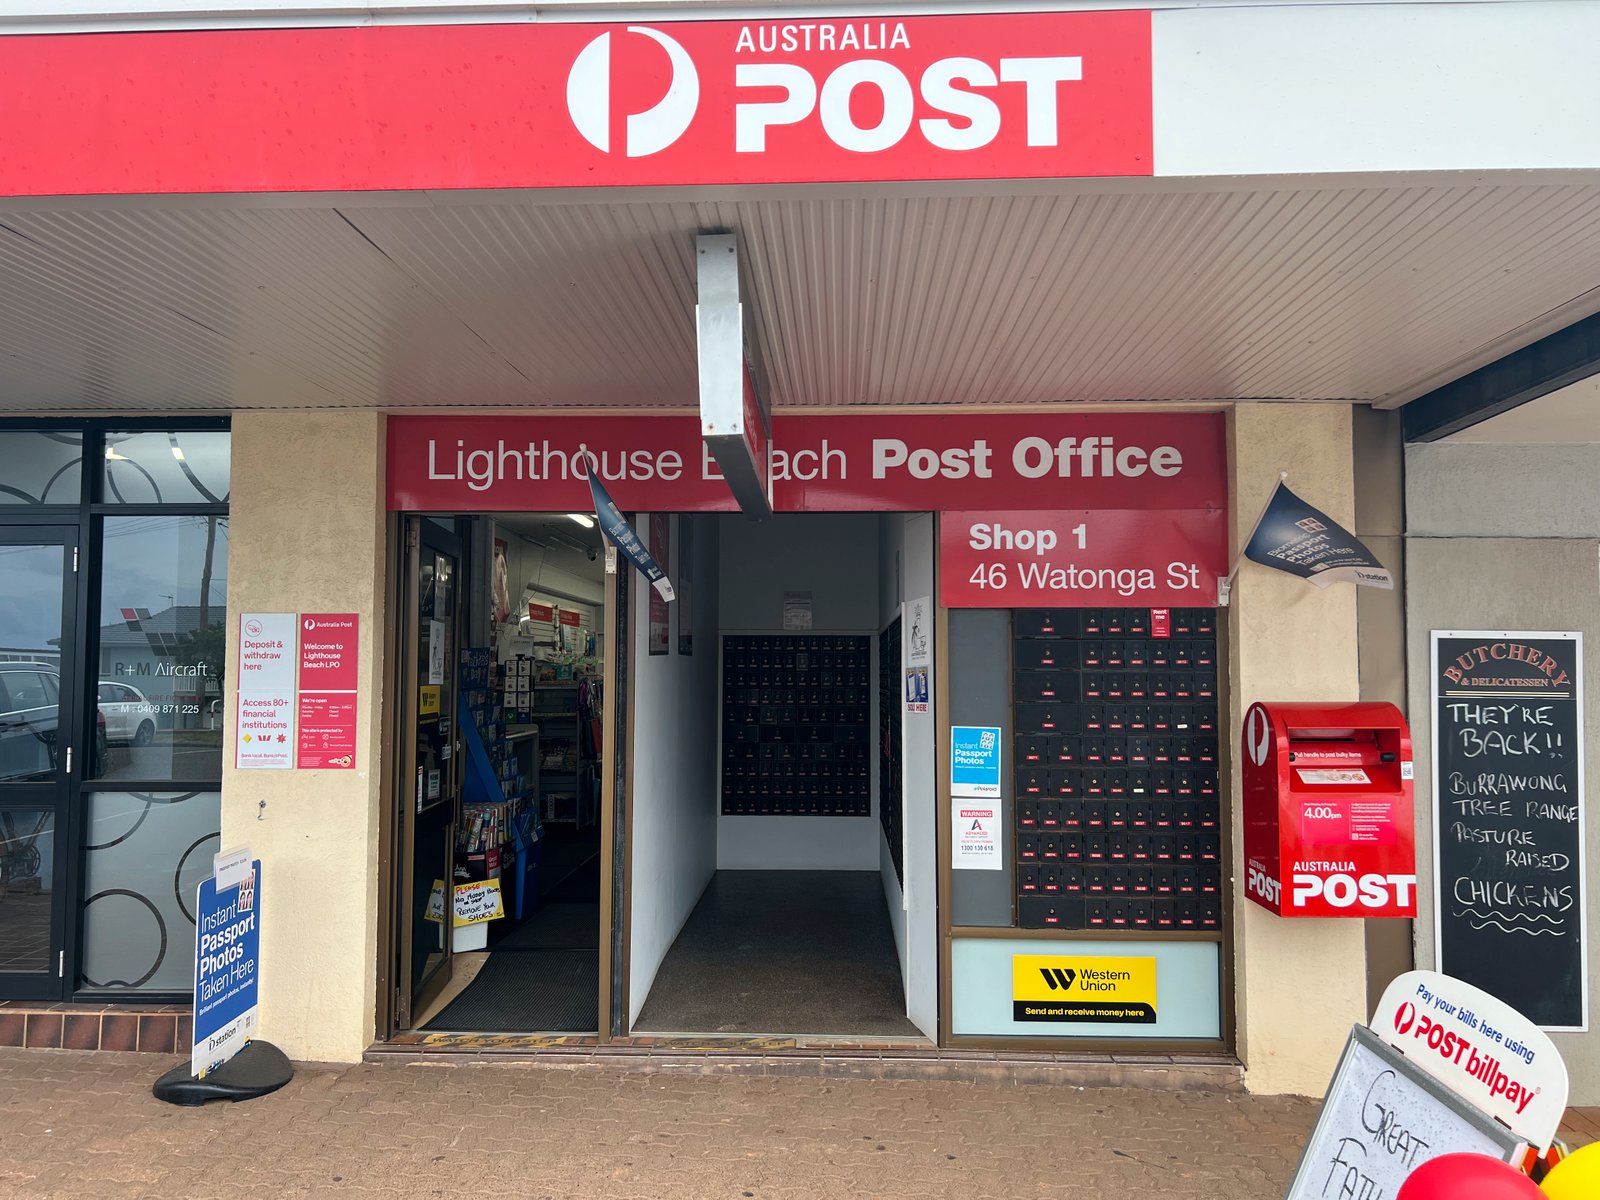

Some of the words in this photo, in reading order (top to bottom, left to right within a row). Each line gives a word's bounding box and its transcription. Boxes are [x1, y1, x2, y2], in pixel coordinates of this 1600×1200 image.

[735, 23, 911, 53] AUSTRALIA
[735, 56, 1082, 152] POST
[428, 439, 682, 491] Lighthouse
[872, 438, 993, 479] Post
[1012, 436, 1183, 479] Office
[969, 523, 1057, 555] Shop
[1072, 523, 1087, 549] 1
[1276, 533, 1330, 560] Passport
[1285, 542, 1330, 563] Photos
[1295, 550, 1330, 566] Taken
[1327, 546, 1355, 556] Here
[969, 562, 1007, 589] 46
[1017, 562, 1155, 596] Watonga
[1166, 561, 1200, 589] St
[244, 640, 275, 650] Deposit
[276, 640, 283, 648] &
[244, 651, 281, 660] withdraw
[244, 662, 262, 671] here
[304, 652, 341, 660] Lighthouse
[1442, 642, 1571, 688] BUTCHERY
[115, 662, 150, 676] R+M
[1460, 678, 1470, 686] &
[1471, 677, 1549, 687] DELICATESSEN
[121, 705, 129, 713] M
[137, 705, 160, 713] 0409
[162, 705, 179, 713] 871
[182, 705, 199, 713] 225
[243, 699, 272, 707] Access
[243, 709, 276, 718] financial
[242, 720, 287, 729] institutions
[1446, 703, 1553, 726] THEY'RE
[955, 749, 992, 759] Passport
[955, 757, 984, 765] Photos
[1449, 771, 1567, 796] BURRAWONG
[1304, 807, 1342, 820] 4.00pm
[1452, 799, 1513, 817] TREE
[1526, 801, 1579, 823] RANGE
[1451, 821, 1537, 846] PASTURE
[1293, 861, 1356, 871] AUSTRALIA
[1506, 849, 1570, 871] RAISED
[456, 883, 481, 894] PLEASE
[1249, 867, 1282, 906] POST
[1293, 873, 1416, 907] POST
[1454, 876, 1573, 912] CHICKENS
[201, 899, 236, 933] Instant
[457, 905, 482, 916] REMOVE
[468, 911, 493, 922] SHOES
[200, 912, 255, 957] Passport
[200, 942, 244, 981] Photos
[199, 973, 229, 1002] Taken
[230, 959, 254, 985] Here
[1079, 968, 1130, 980] Western
[1080, 980, 1116, 991] Union
[199, 1002, 213, 1016] Brilliant
[213, 993, 228, 1009] passport
[1025, 1007, 1046, 1015] Send
[1047, 1007, 1063, 1015] and
[1064, 1008, 1095, 1016] receive
[1096, 1009, 1124, 1018] money
[1125, 1009, 1144, 1017] here
[1416, 983, 1434, 1004] Pay
[1434, 997, 1456, 1015] your
[1457, 1007, 1478, 1029] bills
[1479, 1020, 1503, 1042] here
[1504, 1040, 1535, 1065] using
[215, 1026, 237, 1047] station
[1414, 1015, 1470, 1065] POST
[1465, 1047, 1535, 1115] billpay
[1362, 1070, 1430, 1170] GREAT
